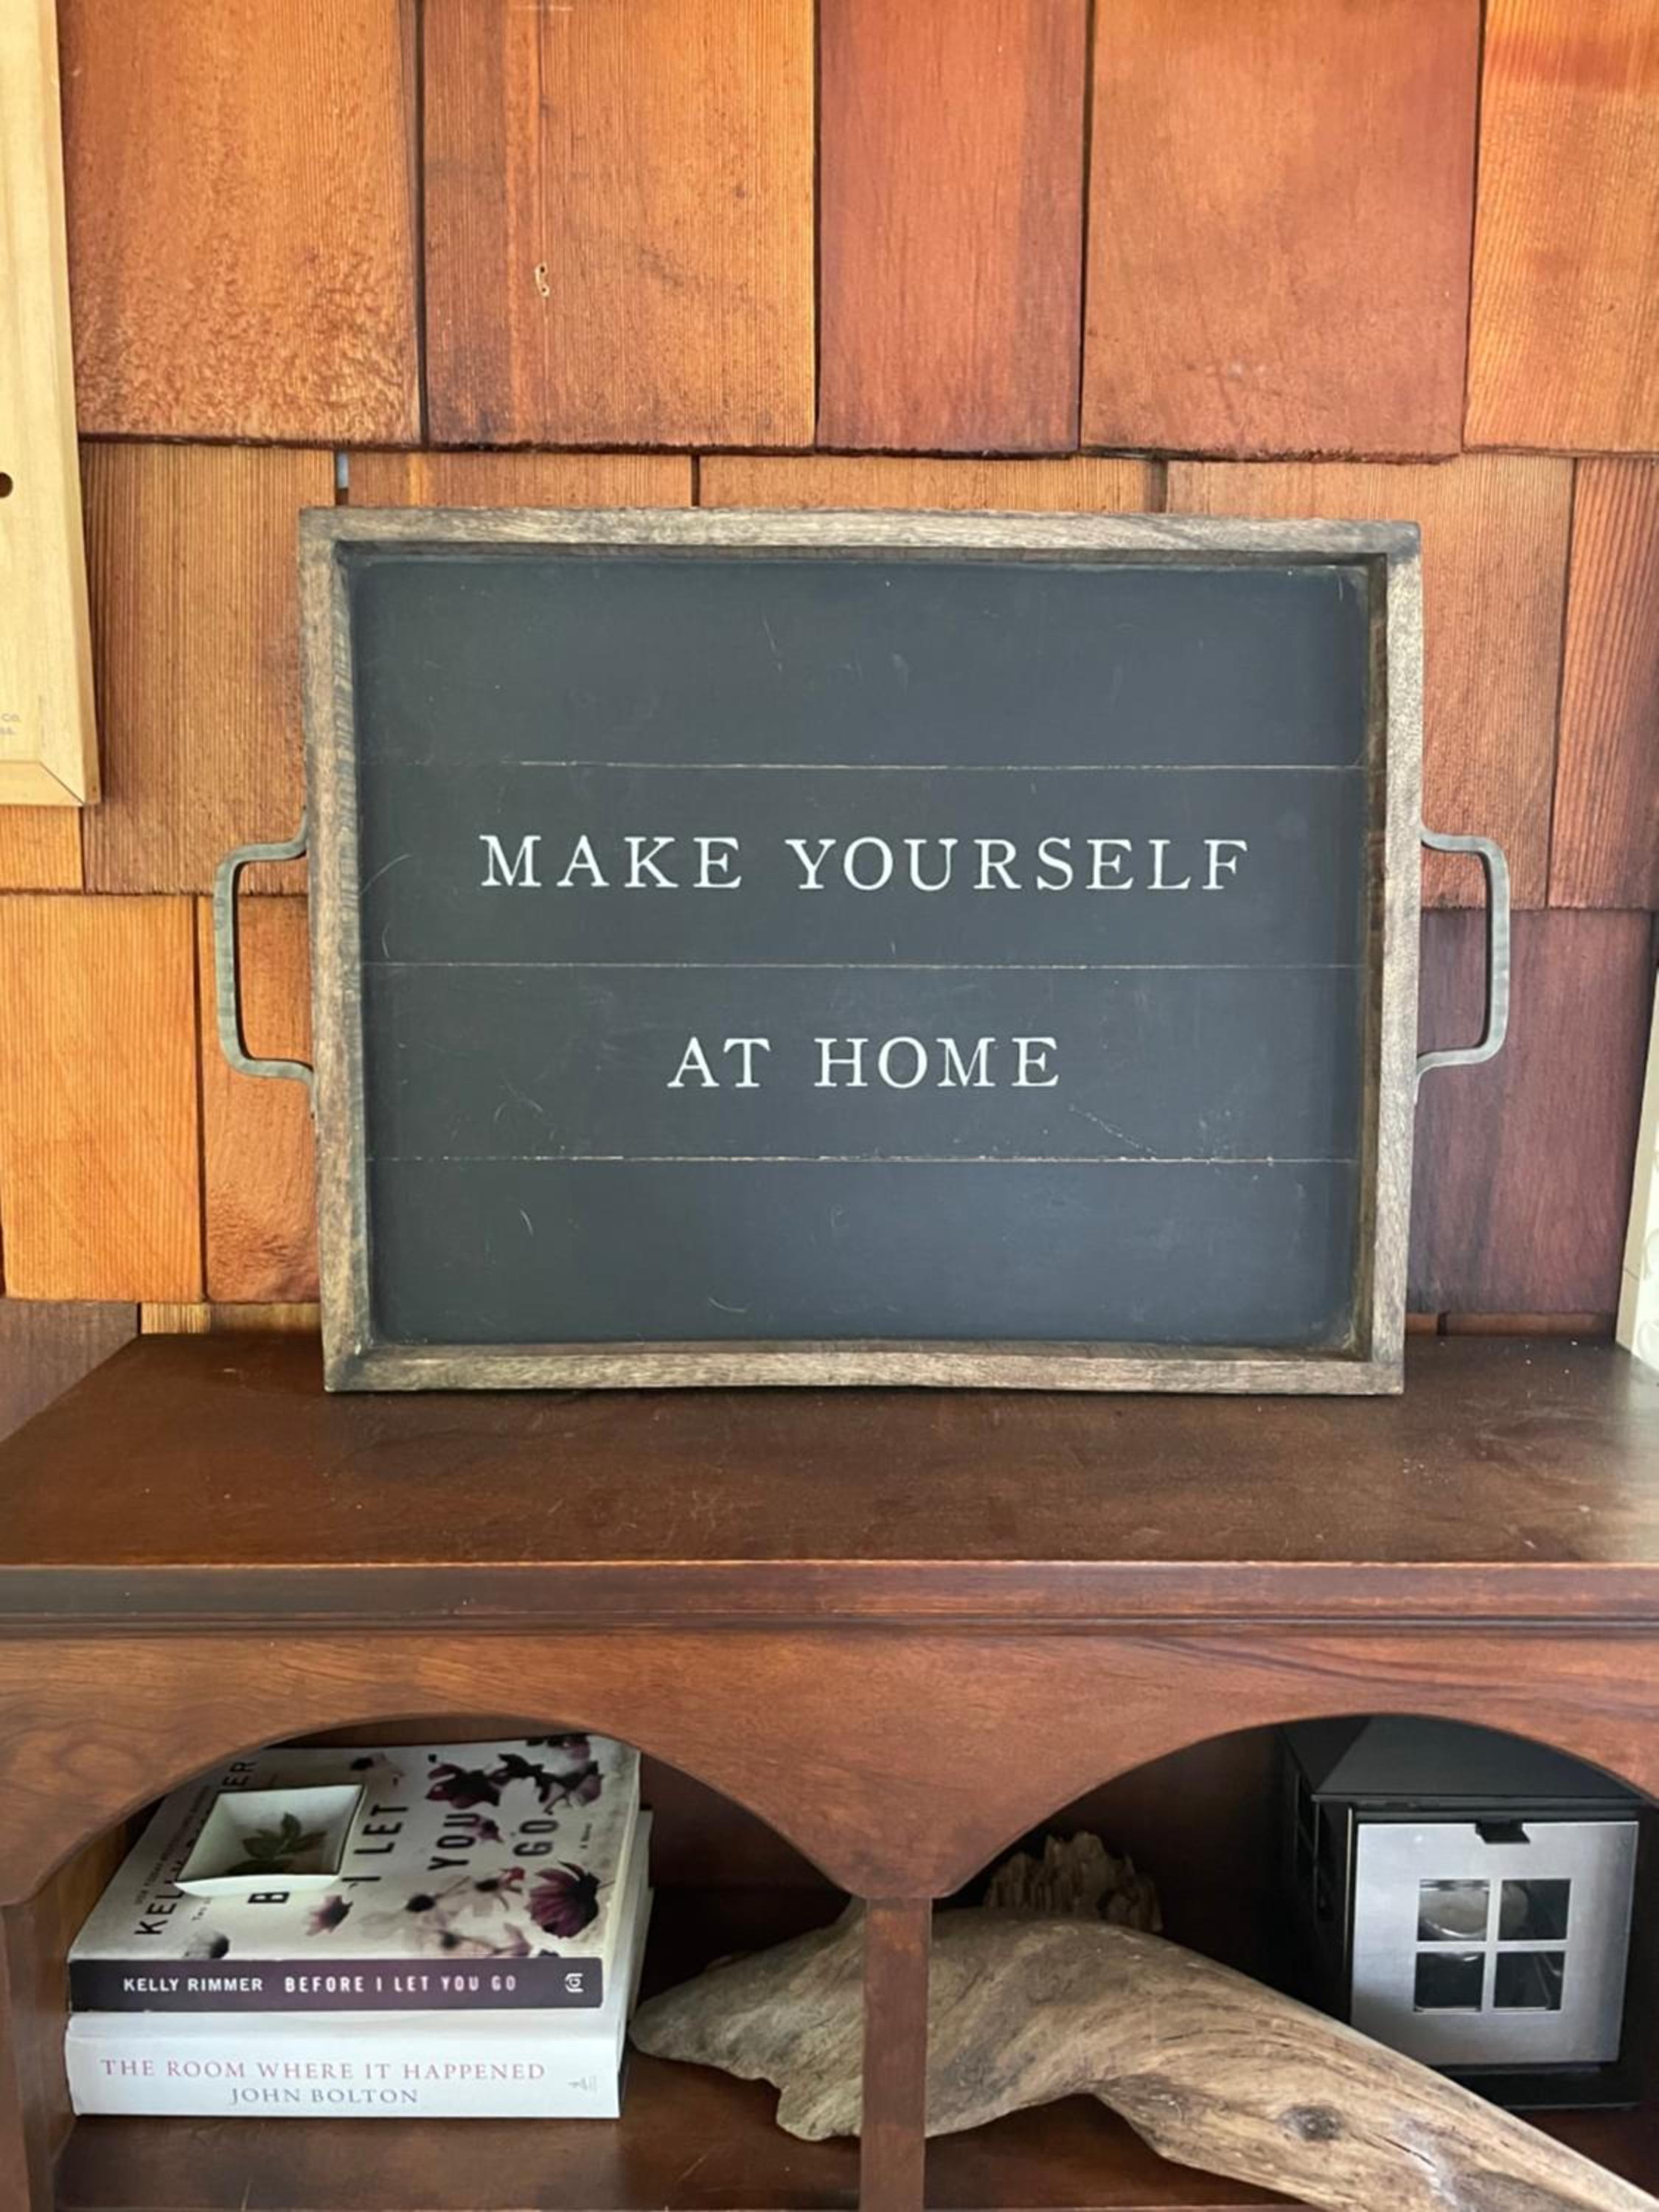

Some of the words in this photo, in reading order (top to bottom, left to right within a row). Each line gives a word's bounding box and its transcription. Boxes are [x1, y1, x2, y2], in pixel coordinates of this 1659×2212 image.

[479, 835, 742, 888] MAKE
[784, 836, 1248, 891] YOURSELF
[667, 1036, 771, 1089] AT
[813, 1036, 1060, 1089] HOME
[353, 1804, 408, 1854] LET
[427, 1812, 481, 1871] YOU
[512, 1820, 559, 1857] GO
[123, 1977, 179, 1992] KELLY
[187, 1977, 263, 1992] RIMMER
[285, 1975, 365, 1993] BEFORE
[375, 1975, 383, 1993] I
[393, 1975, 430, 1993] LET
[440, 1975, 480, 1992] YOU
[490, 1975, 517, 1992] GO
[101, 2059, 156, 2078] THE
[167, 2060, 246, 2079] ROOM
[257, 2062, 354, 2080] WHERE
[365, 2063, 392, 2080] IT
[403, 2063, 546, 2081] HAPPENED
[229, 2087, 301, 2106] JOHN
[310, 2088, 419, 2104] BOLTON
